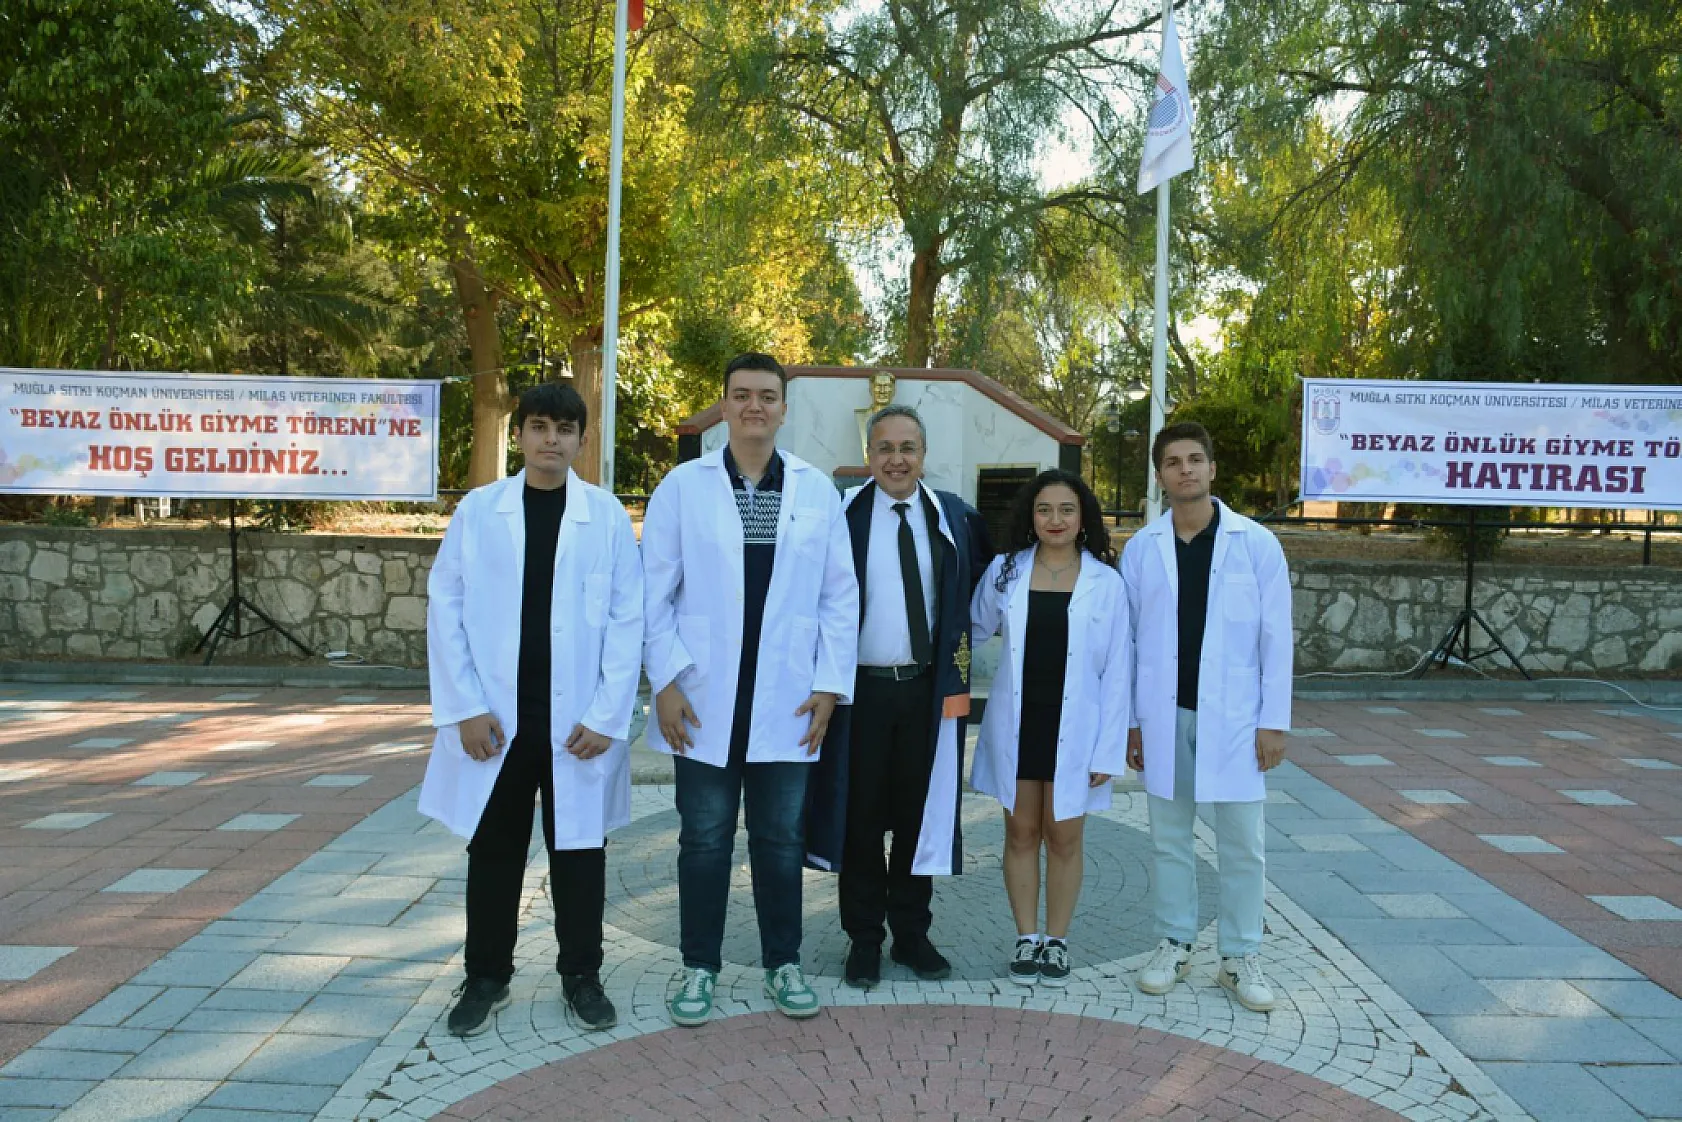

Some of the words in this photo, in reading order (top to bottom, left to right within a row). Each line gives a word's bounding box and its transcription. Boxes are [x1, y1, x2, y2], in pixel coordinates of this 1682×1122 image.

[13, 382, 56, 395] MUĞLA
[61, 385, 92, 397] SITKI
[97, 385, 147, 399] KOÇMAN
[152, 386, 235, 401] ÜNİVERSİTESİ
[249, 390, 286, 402] MİLAS
[291, 391, 357, 404] VETERİNER
[1350, 391, 1391, 404] MUĞLA
[1395, 393, 1426, 405] SITKI
[1429, 394, 1481, 408] KOÇMAN
[1484, 395, 1567, 408] ÜNİVERSİTESİ
[1581, 397, 1619, 409] MİLAS
[109, 406, 193, 433] ÖNLÜK
[200, 409, 278, 434] GİYME
[1445, 432, 1536, 454] ÖNLÜK
[1546, 434, 1634, 457] GİYME
[88, 445, 153, 478] HOŞ
[164, 441, 348, 476] GELDİNİZ...
[1445, 460, 1647, 494] HATIRASI
